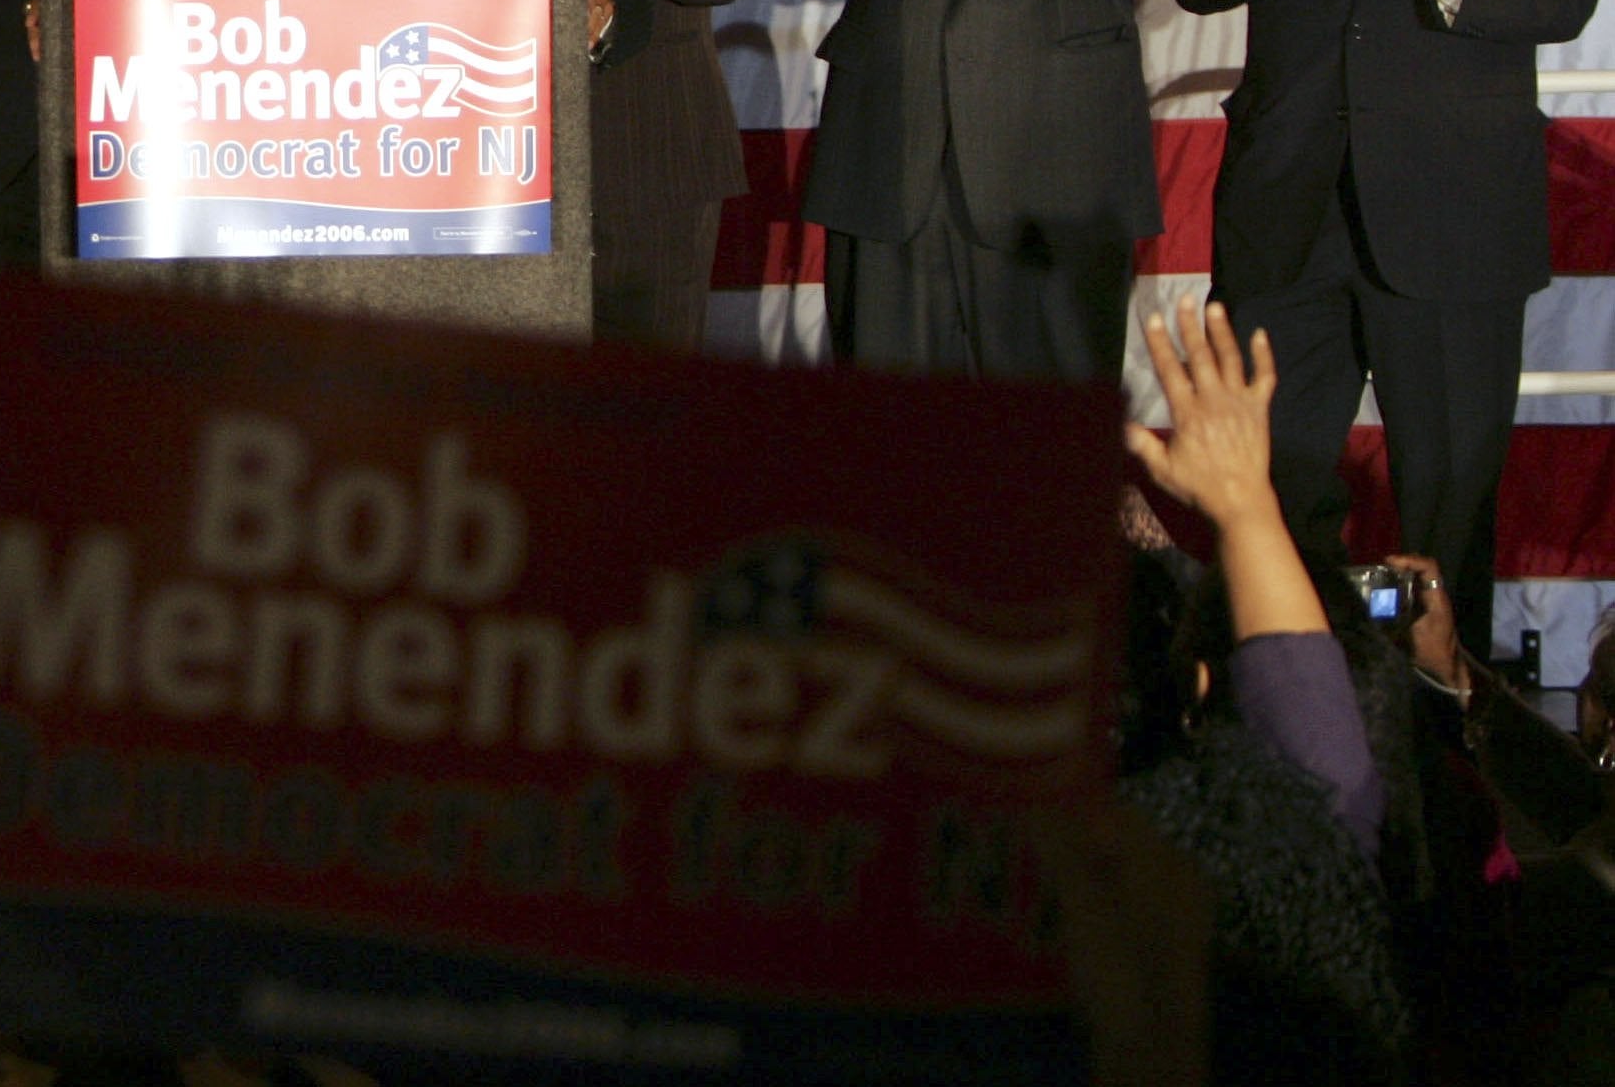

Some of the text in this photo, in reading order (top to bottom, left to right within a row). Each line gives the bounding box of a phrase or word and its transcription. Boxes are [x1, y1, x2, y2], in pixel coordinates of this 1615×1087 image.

[89, 44, 462, 122] Menendez
[377, 124, 461, 177] for
[478, 125, 537, 184] NJ
[190, 408, 529, 607] Bob
[670, 774, 883, 922] for
